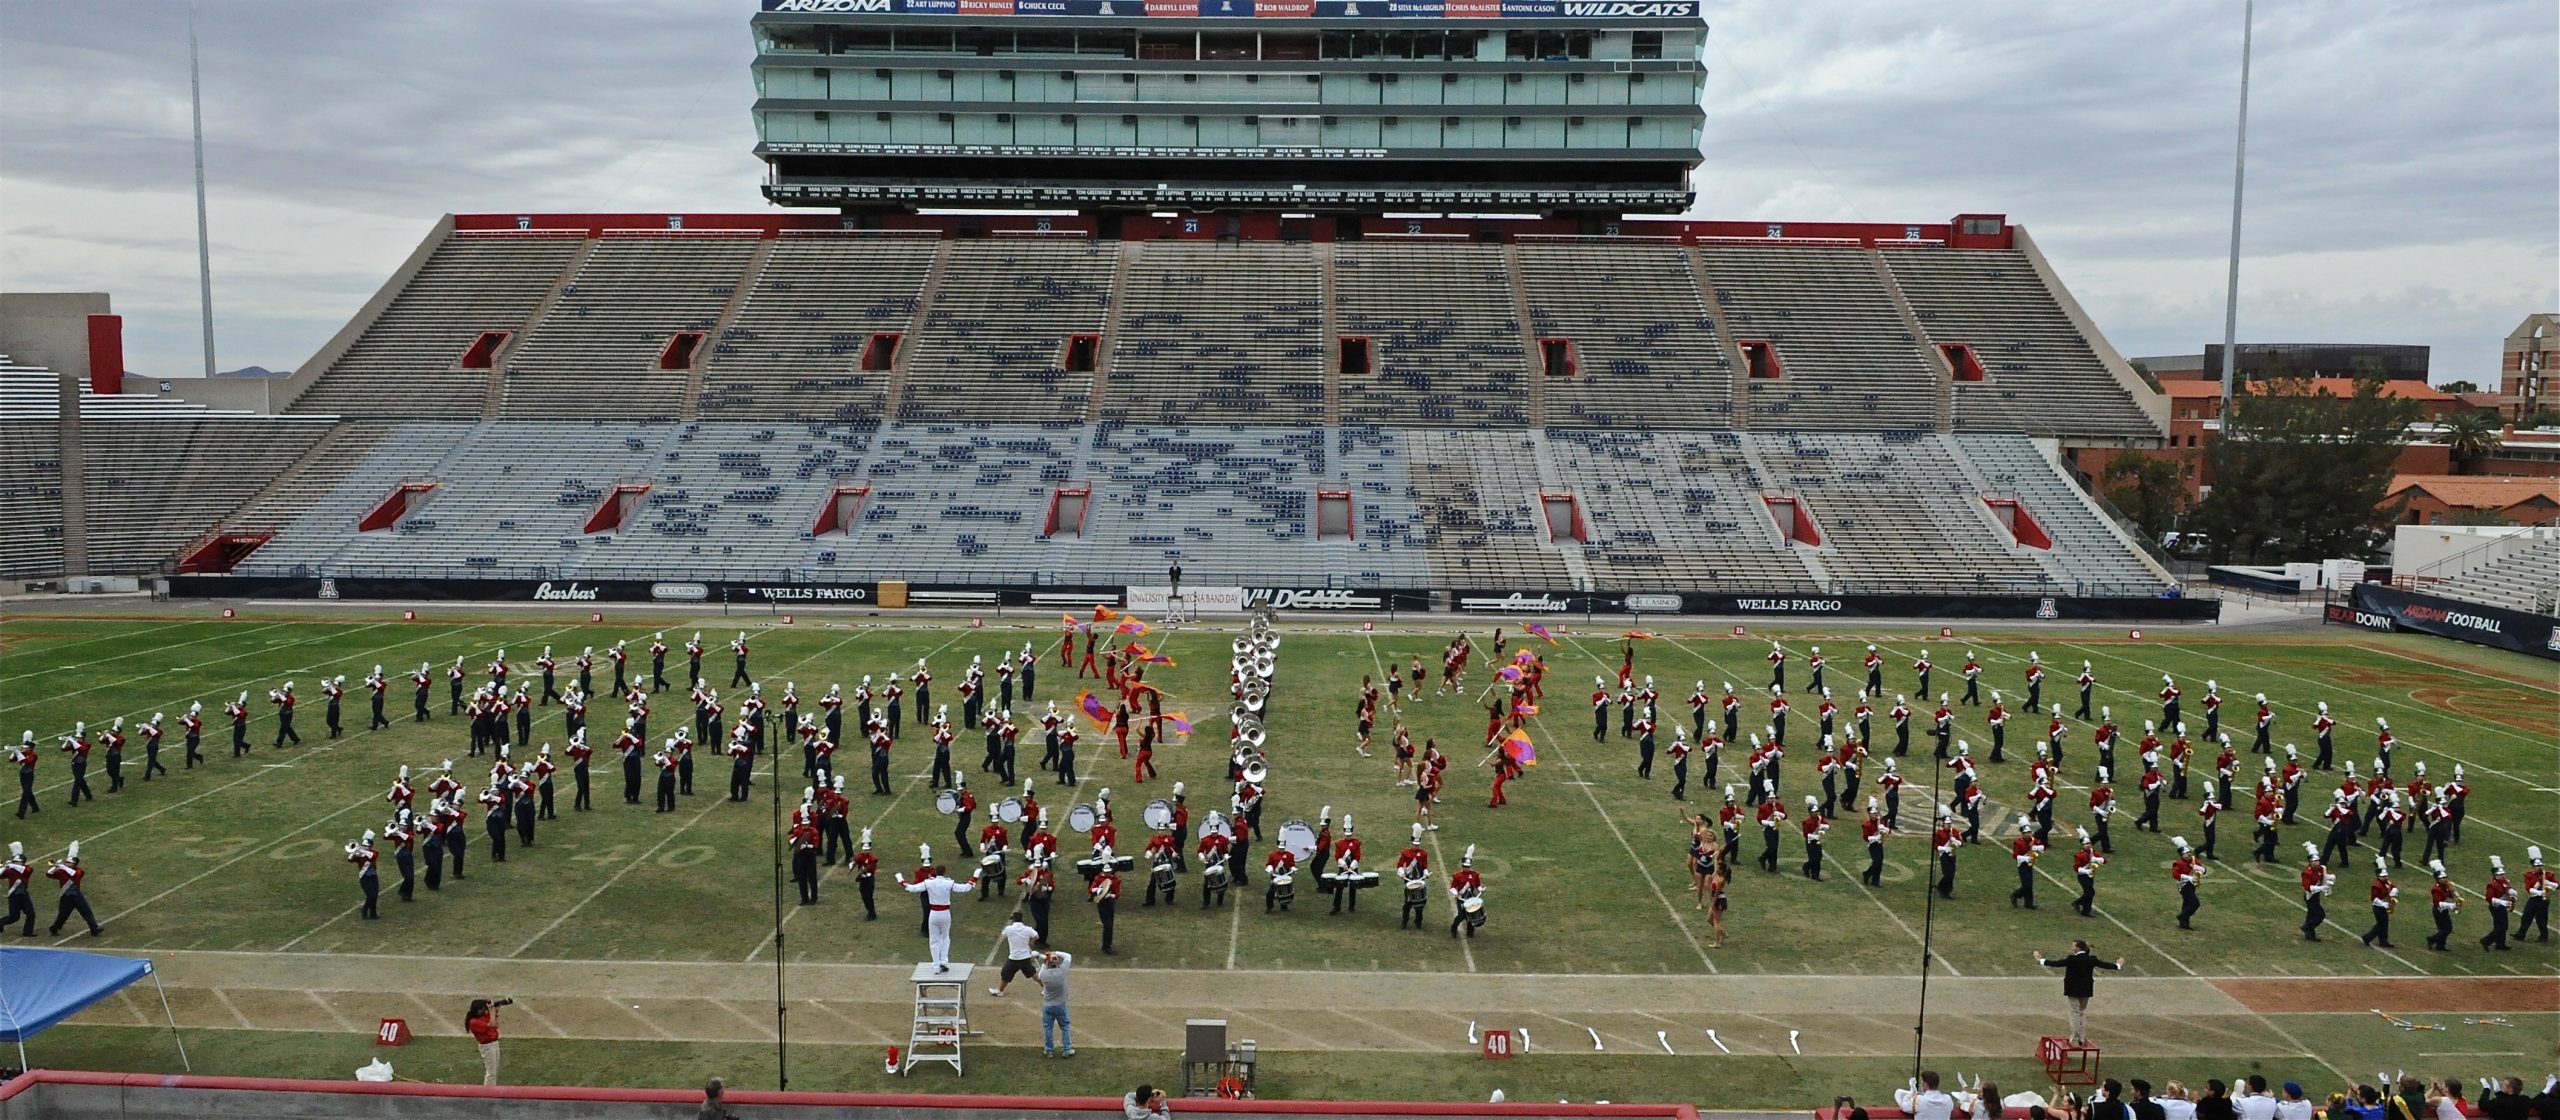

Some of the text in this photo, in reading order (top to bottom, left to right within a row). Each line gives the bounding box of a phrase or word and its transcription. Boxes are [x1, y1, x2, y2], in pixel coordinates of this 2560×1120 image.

[775, 0, 891, 11] ARIZONA
[969, 1, 988, 9] RICKY
[989, 1, 1014, 9] HUNLEY
[1024, 1, 1046, 10] CHUCK
[1047, 1, 1066, 10] CECIL
[1150, 3, 1178, 11] DARRYLL
[1179, 3, 1198, 11] LEWIS
[1263, 3, 1277, 11] ROB
[1278, 3, 1309, 11] WALDROP
[1452, 3, 1469, 11] CHRIS
[1470, 3, 1500, 11] McALISTER
[1507, 4, 1533, 12] ANTOINE
[1534, 4, 1556, 12] CASON
[1564, 3, 1692, 15] WILDCATS
[518, 221, 529, 230] 17
[669, 221, 681, 230] 18
[843, 221, 854, 230] 19
[1038, 222, 1051, 231] 20
[1186, 223, 1197, 232] 21
[1408, 225, 1421, 234] 22
[1606, 227, 1619, 236] 23
[1768, 229, 1780, 238] 24
[1906, 231, 1919, 240] 25
[160, 383, 171, 391] 16
[534, 582, 599, 600] Bashas'
[762, 588, 866, 600] WELLS FARGO
[1130, 594, 1239, 604] UNIVERSITY BAND DAY
[1736, 599, 1842, 612] WELLS FARGO
[2355, 612, 2391, 629] DOWN
[2444, 611, 2501, 634] FOOTBALL
[380, 1022, 399, 1042] 40
[1488, 1034, 1507, 1054] 40
